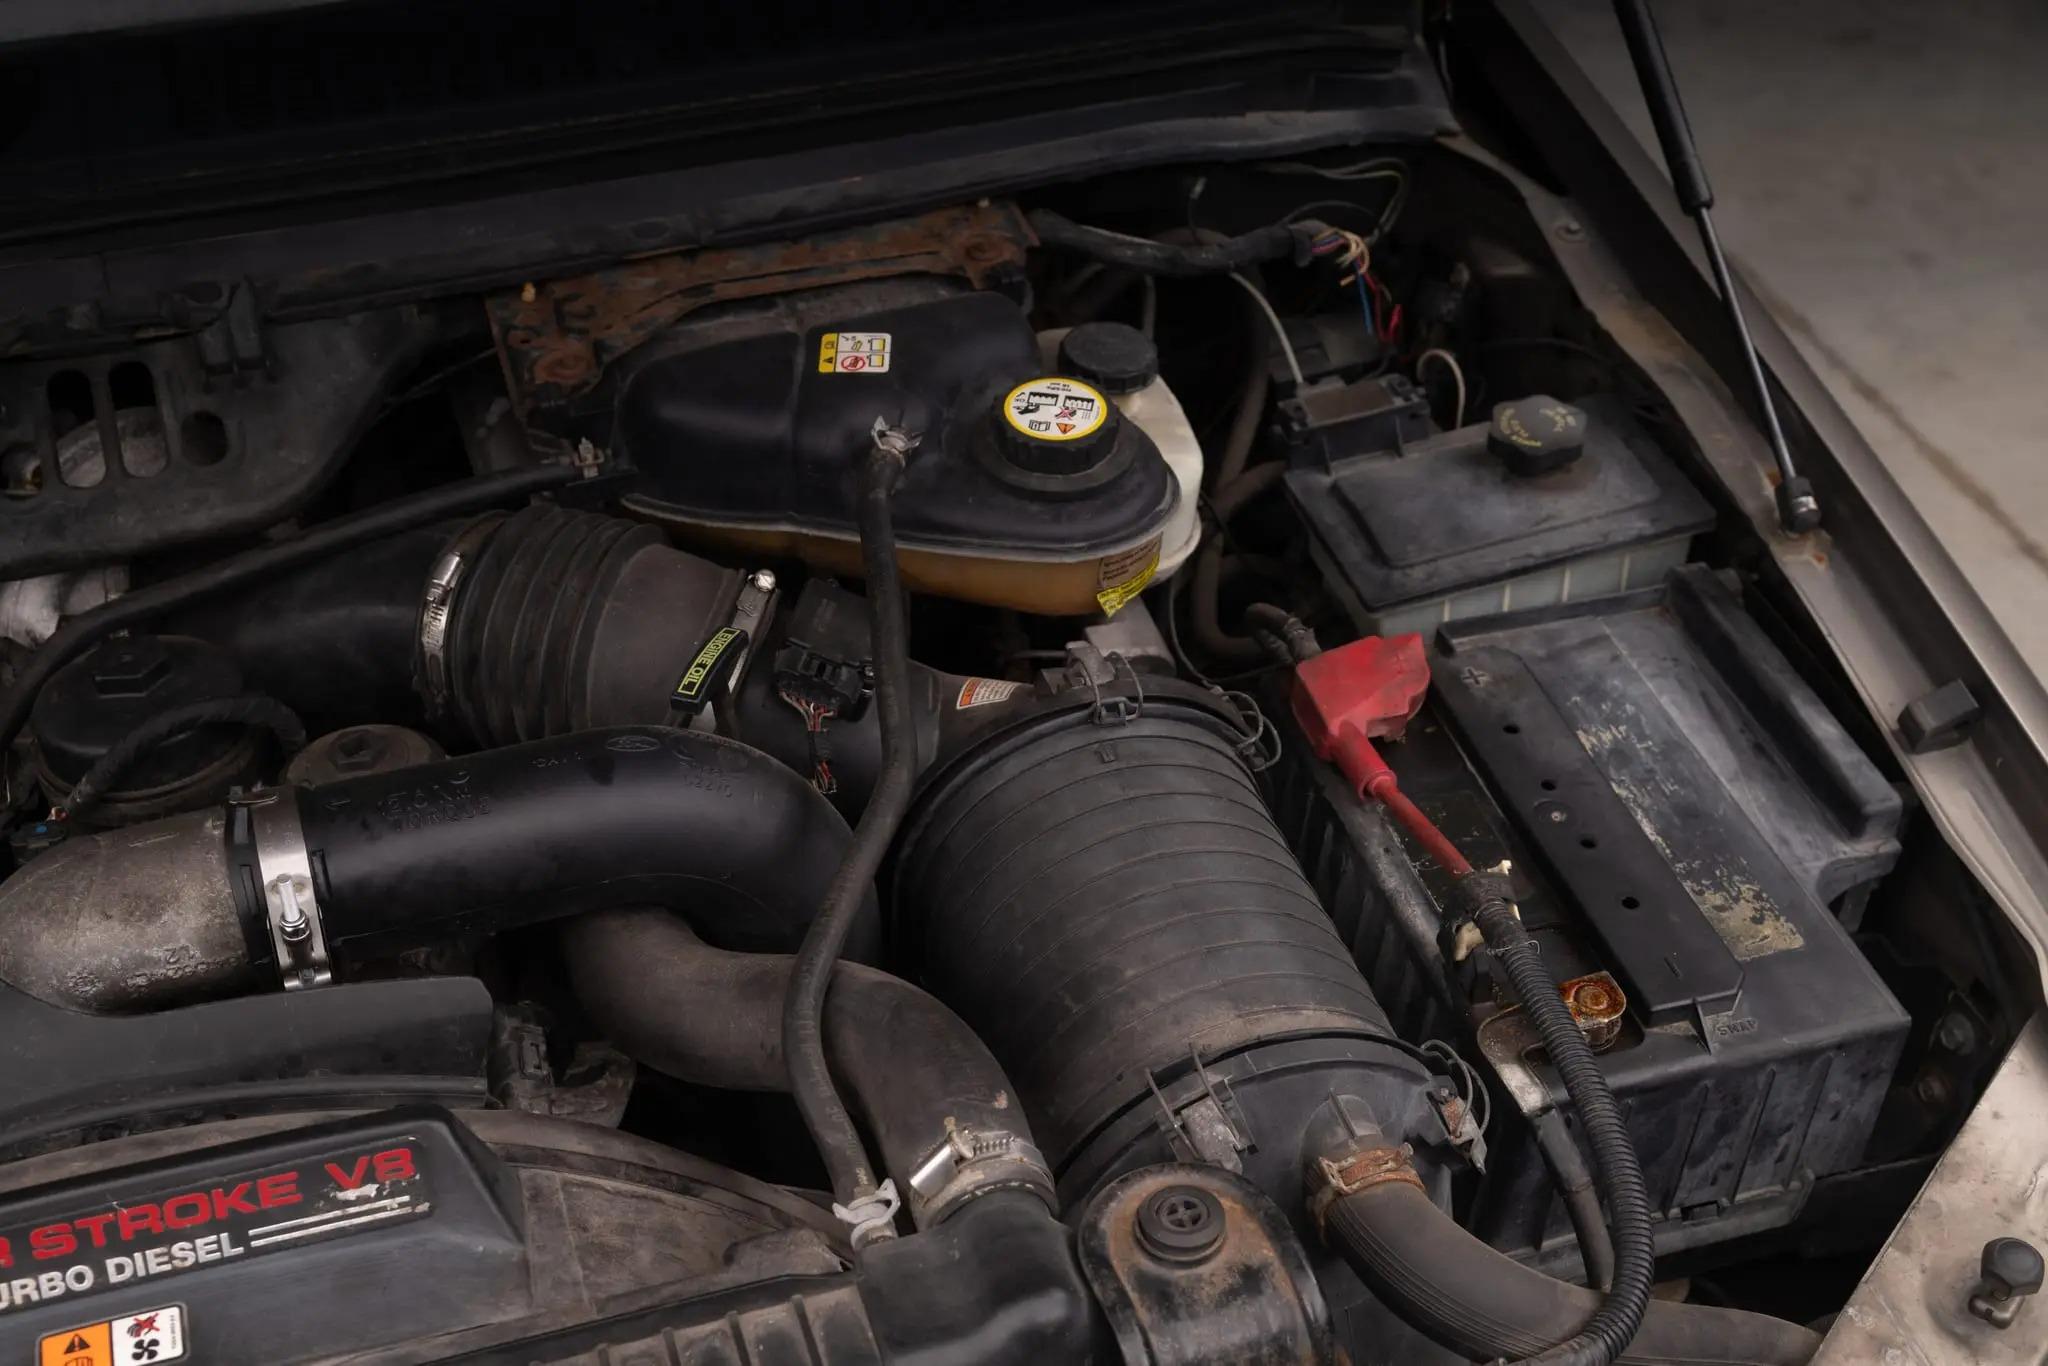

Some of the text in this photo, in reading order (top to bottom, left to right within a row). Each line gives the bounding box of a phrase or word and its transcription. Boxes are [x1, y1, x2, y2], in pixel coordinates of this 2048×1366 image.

[685, 632, 732, 685] ENGINE OIL
[29, 1171, 303, 1260] STROKE
[325, 1148, 416, 1190] V8
[105, 1232, 244, 1284] DIESEL
